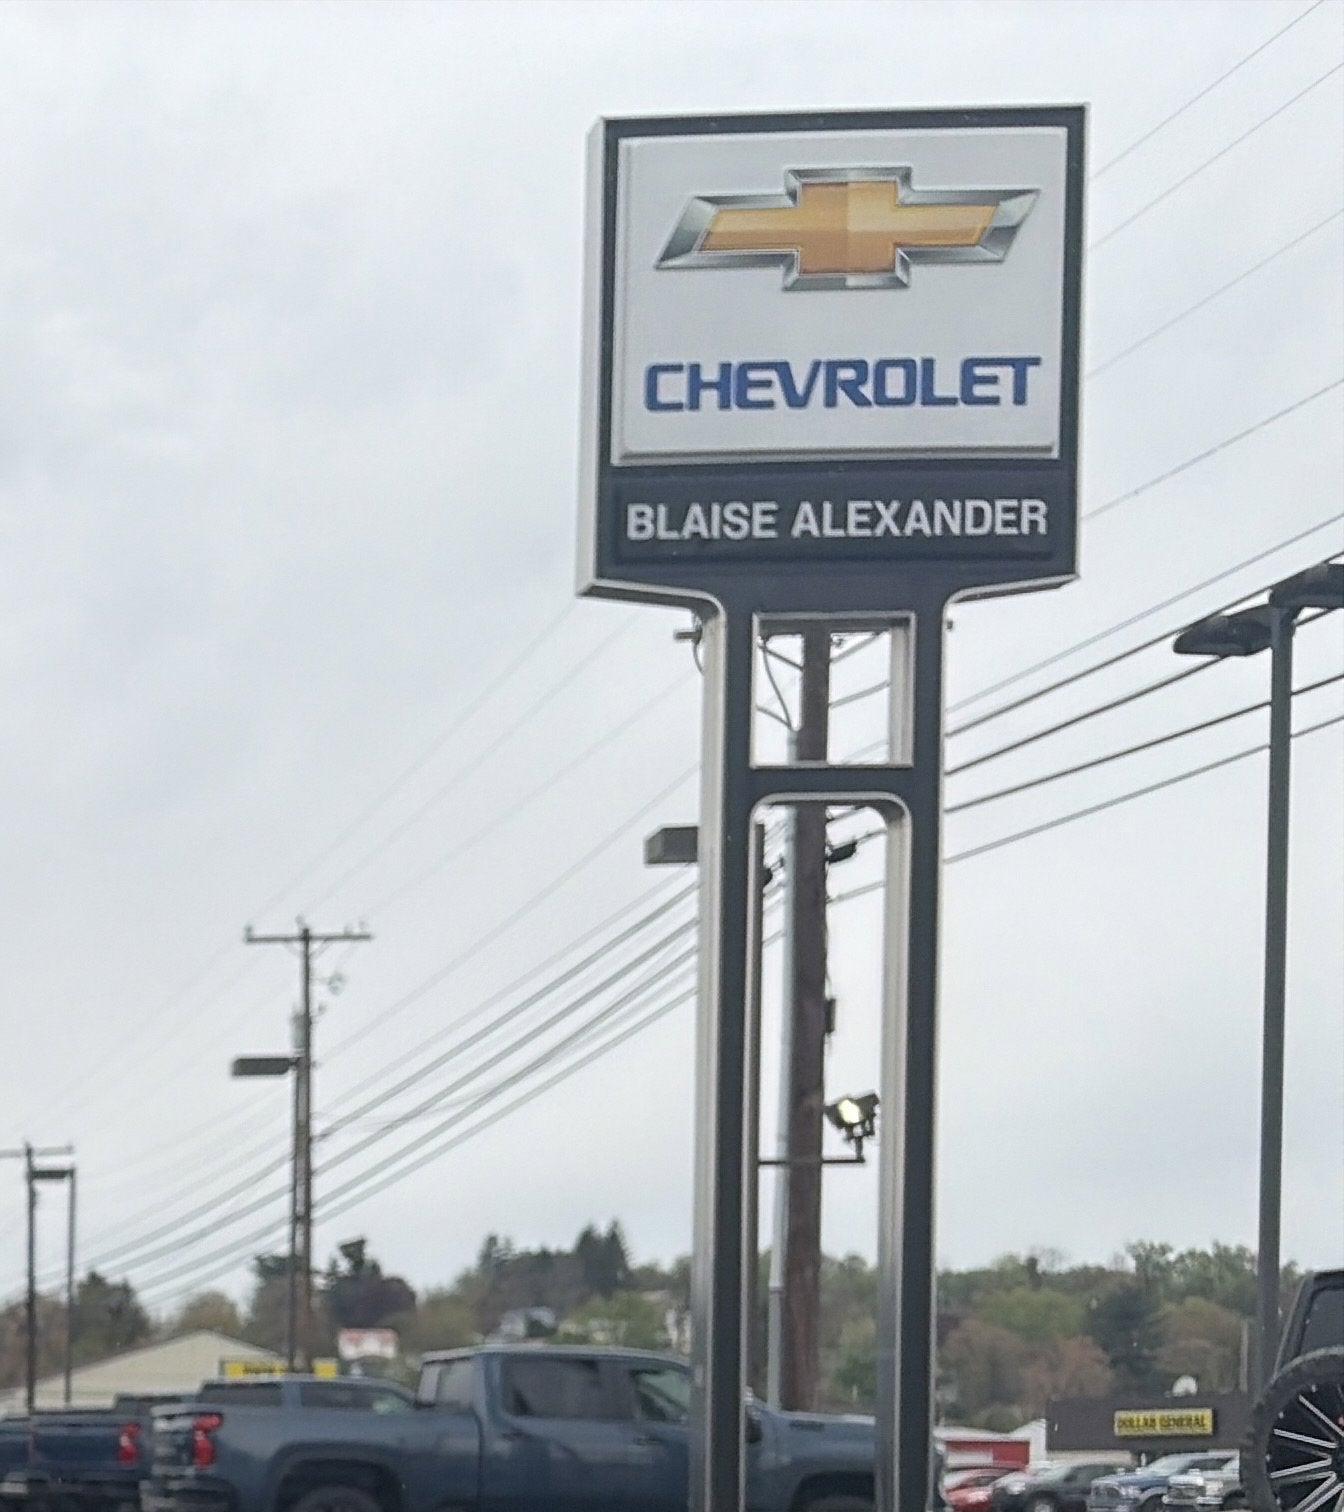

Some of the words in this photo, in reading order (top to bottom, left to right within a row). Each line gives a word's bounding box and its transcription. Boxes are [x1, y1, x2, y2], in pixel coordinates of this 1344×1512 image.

[644, 355, 1042, 412] CHEVROLET
[626, 501, 778, 541] BLAISE
[791, 498, 1048, 538] ALEXANDER
[1159, 1413, 1207, 1430] GENERAL
